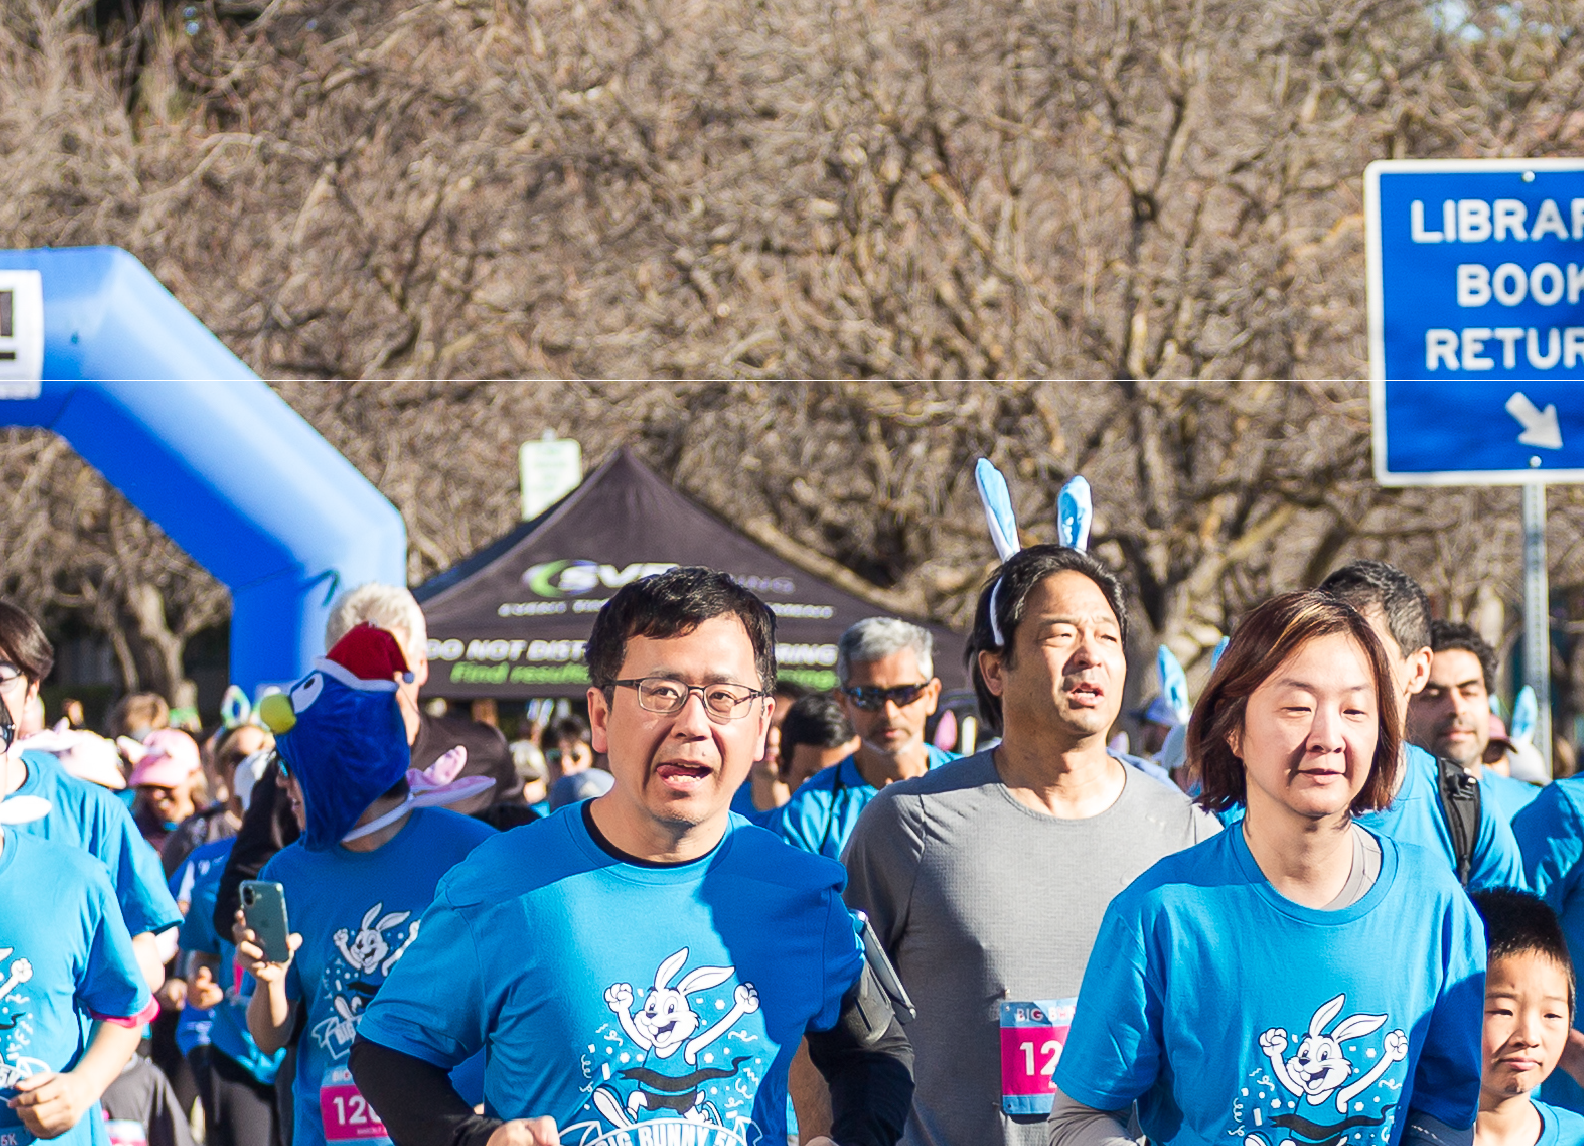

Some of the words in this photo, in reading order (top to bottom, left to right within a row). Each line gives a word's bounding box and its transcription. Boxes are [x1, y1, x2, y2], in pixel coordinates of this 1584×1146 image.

[467, 639, 527, 661] NOT
[527, 639, 589, 661] DIST
[1016, 1008, 1044, 1021] BIG
[1019, 1040, 1064, 1076] 12
[0, 1133, 18, 1146] 5K
